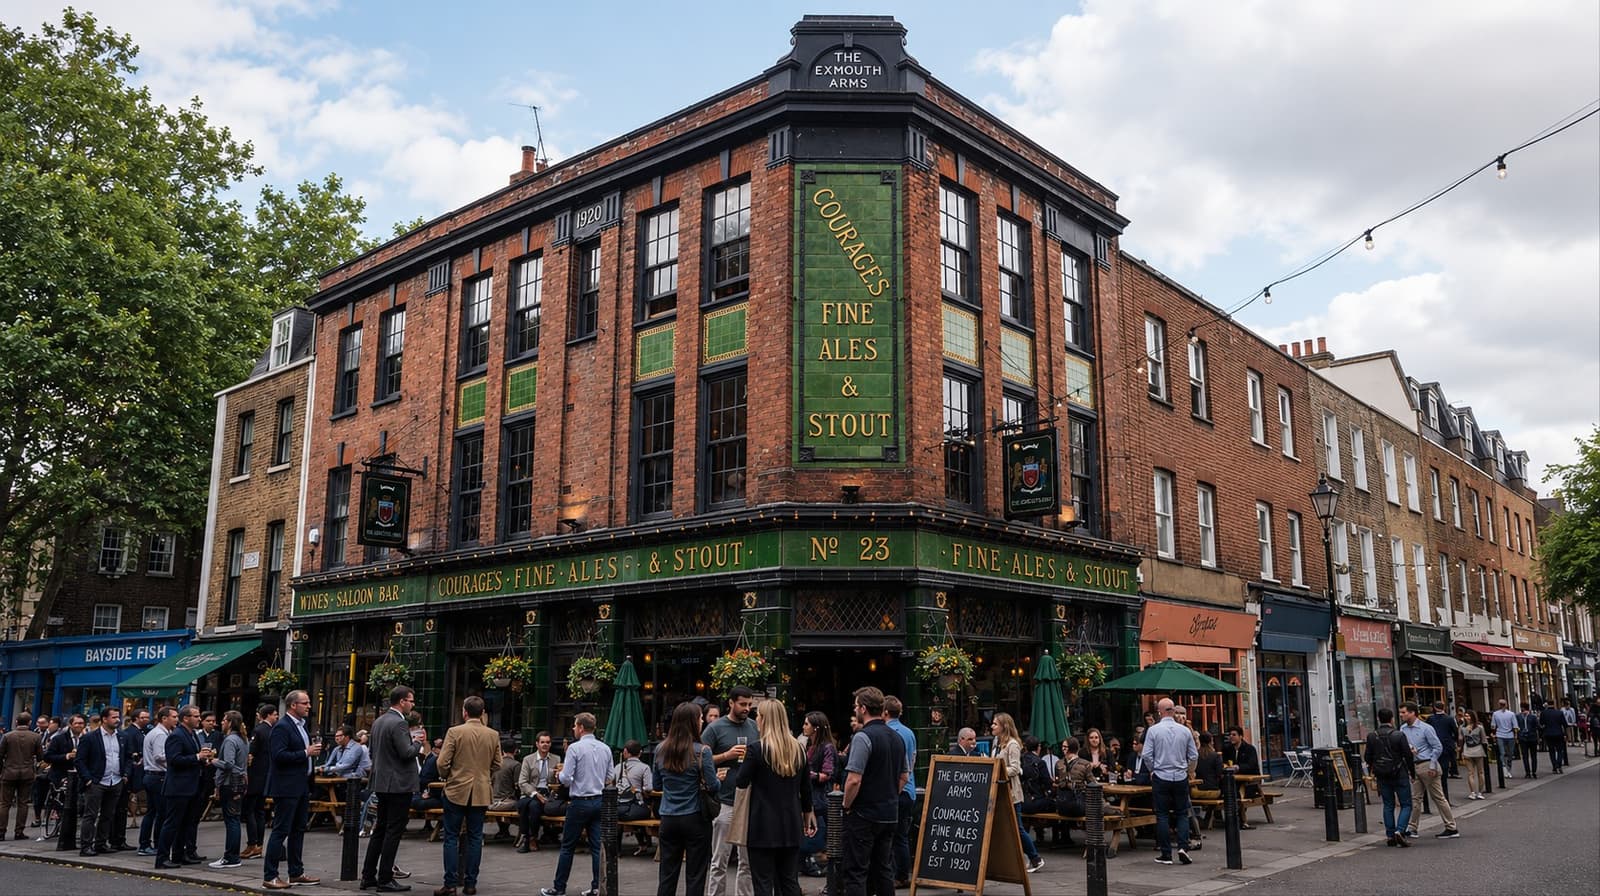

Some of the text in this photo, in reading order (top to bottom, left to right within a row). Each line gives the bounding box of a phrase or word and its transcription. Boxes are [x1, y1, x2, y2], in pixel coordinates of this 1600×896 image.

[834, 52, 862, 63] THE
[815, 65, 882, 76] EXMOUTH
[829, 78, 868, 89] ARMS
[576, 205, 602, 229] 1920
[822, 302, 875, 325] FINE
[818, 338, 878, 361] ALES
[841, 375, 859, 397] &
[808, 412, 892, 437] STOUT
[859, 536, 890, 561] 23
[514, 563, 556, 590] FINE
[567, 556, 618, 583] ALES
[649, 551, 661, 574] &
[673, 541, 743, 572] STOUT
[952, 543, 1129, 590] FINE ALES & STOUT
[300, 584, 400, 611] WINES SALOON BAR
[85, 645, 167, 662] BAYSIDE FISH
[937, 770, 989, 784] THE EXMOUTH
[946, 785, 973, 798] ARMS
[932, 806, 980, 823] COURAGE'S
[930, 824, 978, 840] FINE ALES
[931, 839, 973, 855] & STOUT
[927, 856, 971, 871] EST 1920
